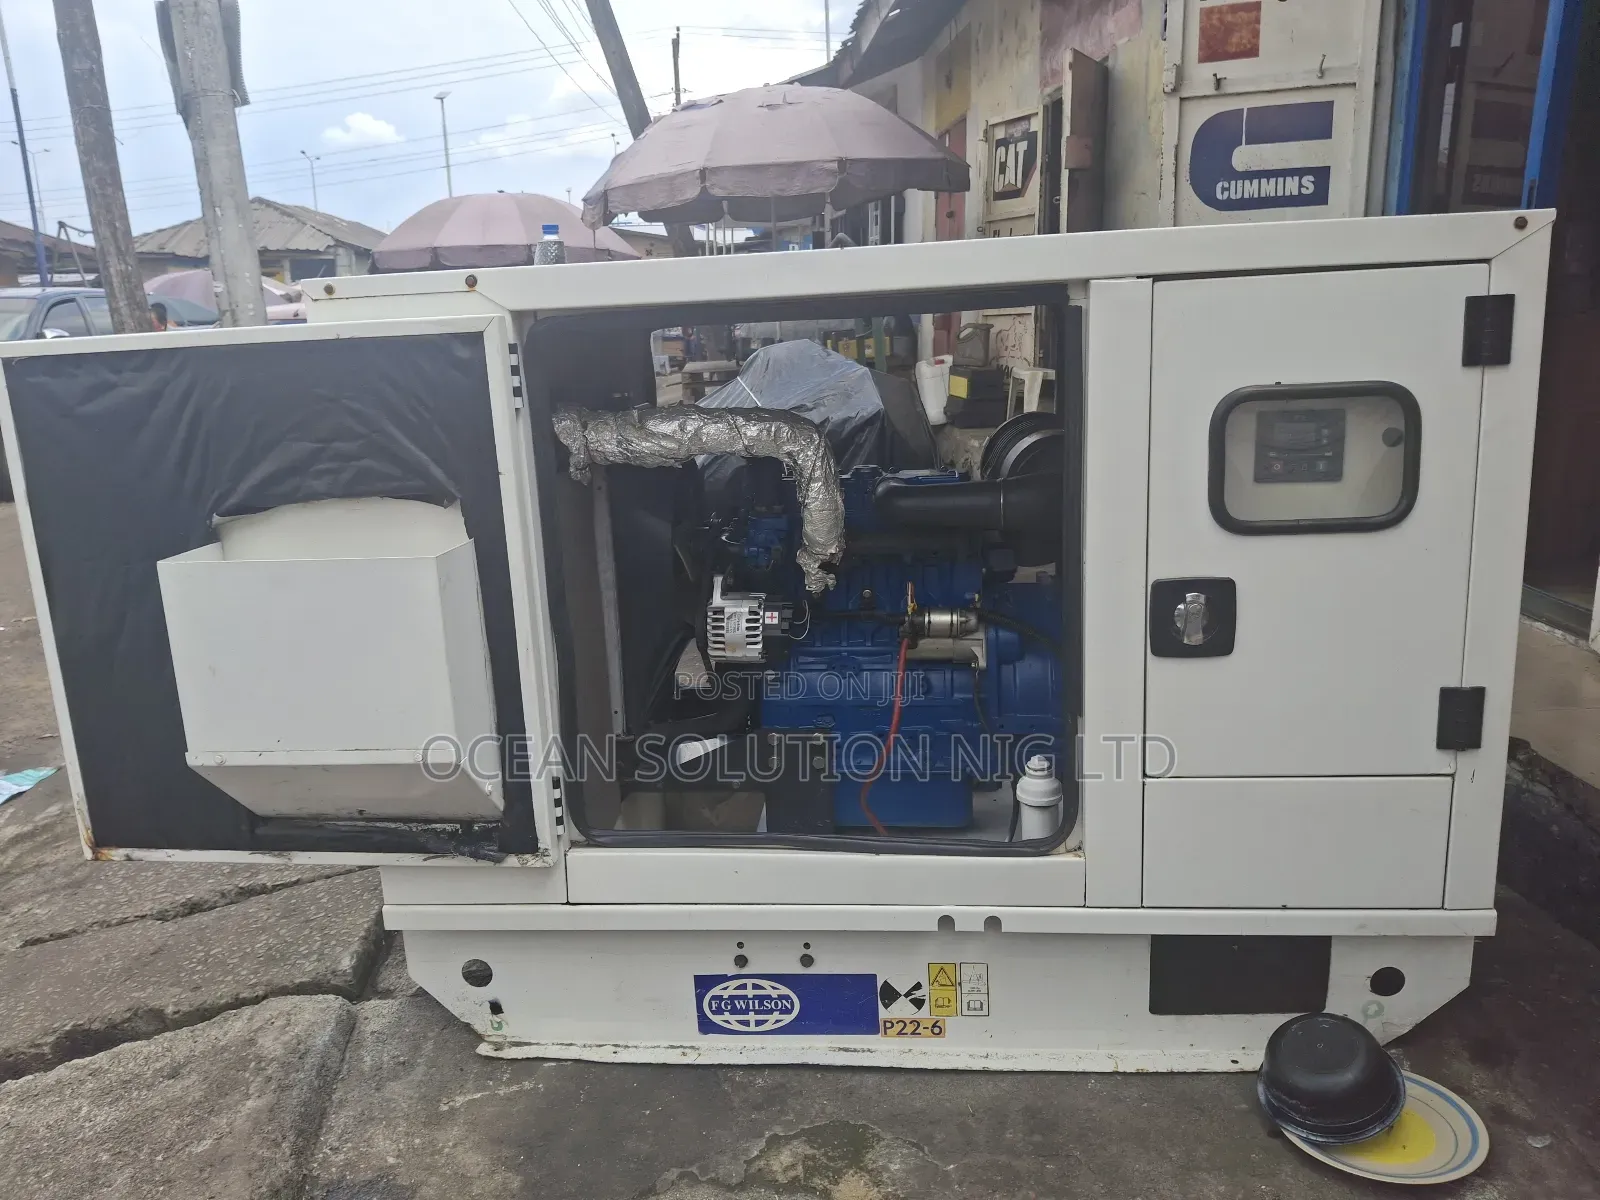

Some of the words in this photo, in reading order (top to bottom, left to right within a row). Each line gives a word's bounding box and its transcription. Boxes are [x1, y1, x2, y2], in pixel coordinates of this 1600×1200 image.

[994, 140, 1028, 192] CAT
[1215, 174, 1315, 200] CUMMINS
[734, 999, 792, 1010] WILSON
[883, 1020, 943, 1036] P22-6
